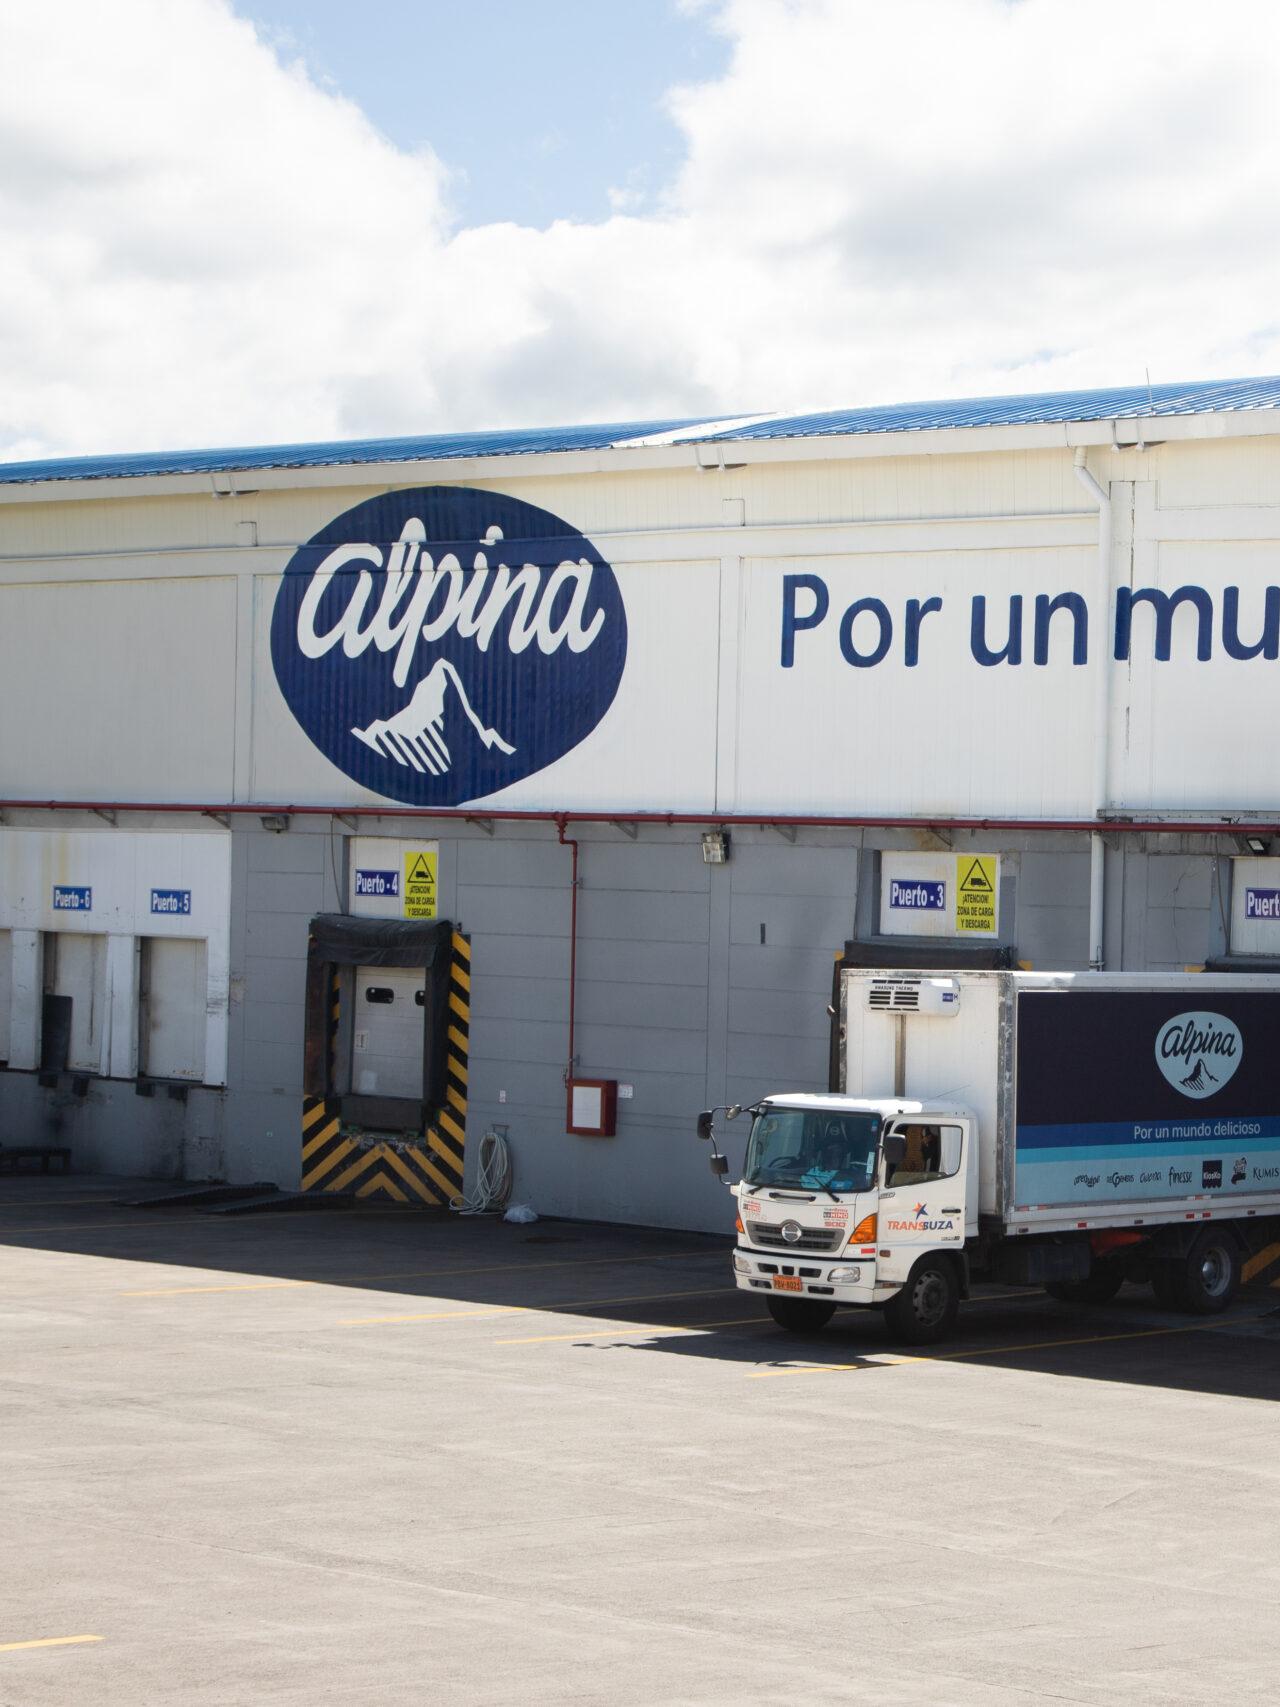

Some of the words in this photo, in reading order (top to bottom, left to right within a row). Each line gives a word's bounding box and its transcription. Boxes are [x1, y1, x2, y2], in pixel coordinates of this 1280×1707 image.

[297, 517, 605, 688] alpina
[780, 574, 942, 668] Por
[970, 593, 1088, 667] un
[356, 872, 385, 894] Puerto
[391, 873, 398, 894] 4
[54, 889, 79, 908] Puerto
[84, 890, 90, 908] 6
[152, 892, 178, 912] Puerto
[183, 893, 190, 912] 5
[892, 883, 928, 907] Puerto
[937, 884, 944, 907] 3
[957, 906, 970, 916] ZONA
[970, 907, 977, 916] DE
[979, 907, 994, 917] CARGA
[965, 919, 991, 929] DESCARGA
[1161, 1019, 1237, 1066] alpina
[1133, 1125, 1153, 1139] Por
[1155, 1127, 1170, 1138] un
[1172, 1122, 1211, 1138] mundo
[1213, 1120, 1261, 1136] delicioso
[1168, 1166, 1193, 1187] finesse
[1253, 1167, 1280, 1180] KUMIS
